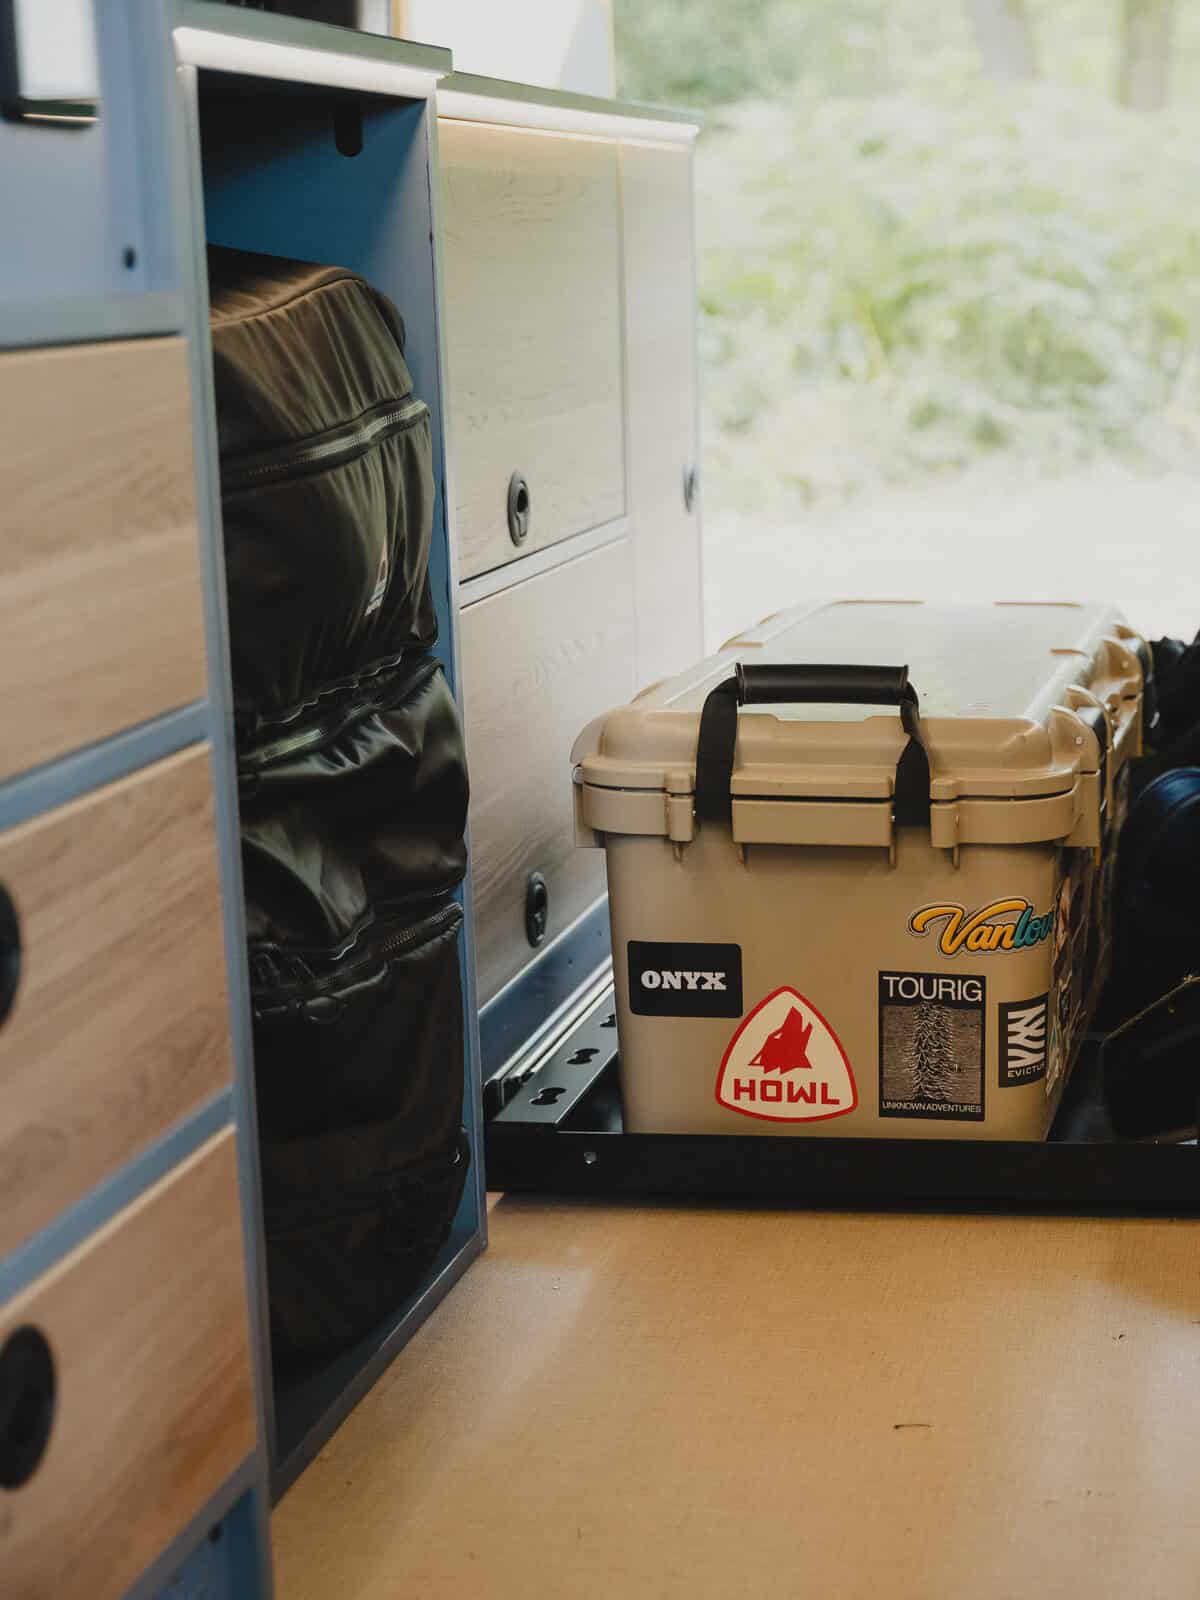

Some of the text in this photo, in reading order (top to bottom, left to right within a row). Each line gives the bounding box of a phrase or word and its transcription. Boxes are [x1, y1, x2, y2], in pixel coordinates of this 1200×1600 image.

[640, 970, 727, 990] ONYX
[882, 976, 983, 1002] TOURIG
[734, 1078, 840, 1105] HOWL
[882, 1101, 982, 1113] UNKNOWN ADVENTURES
